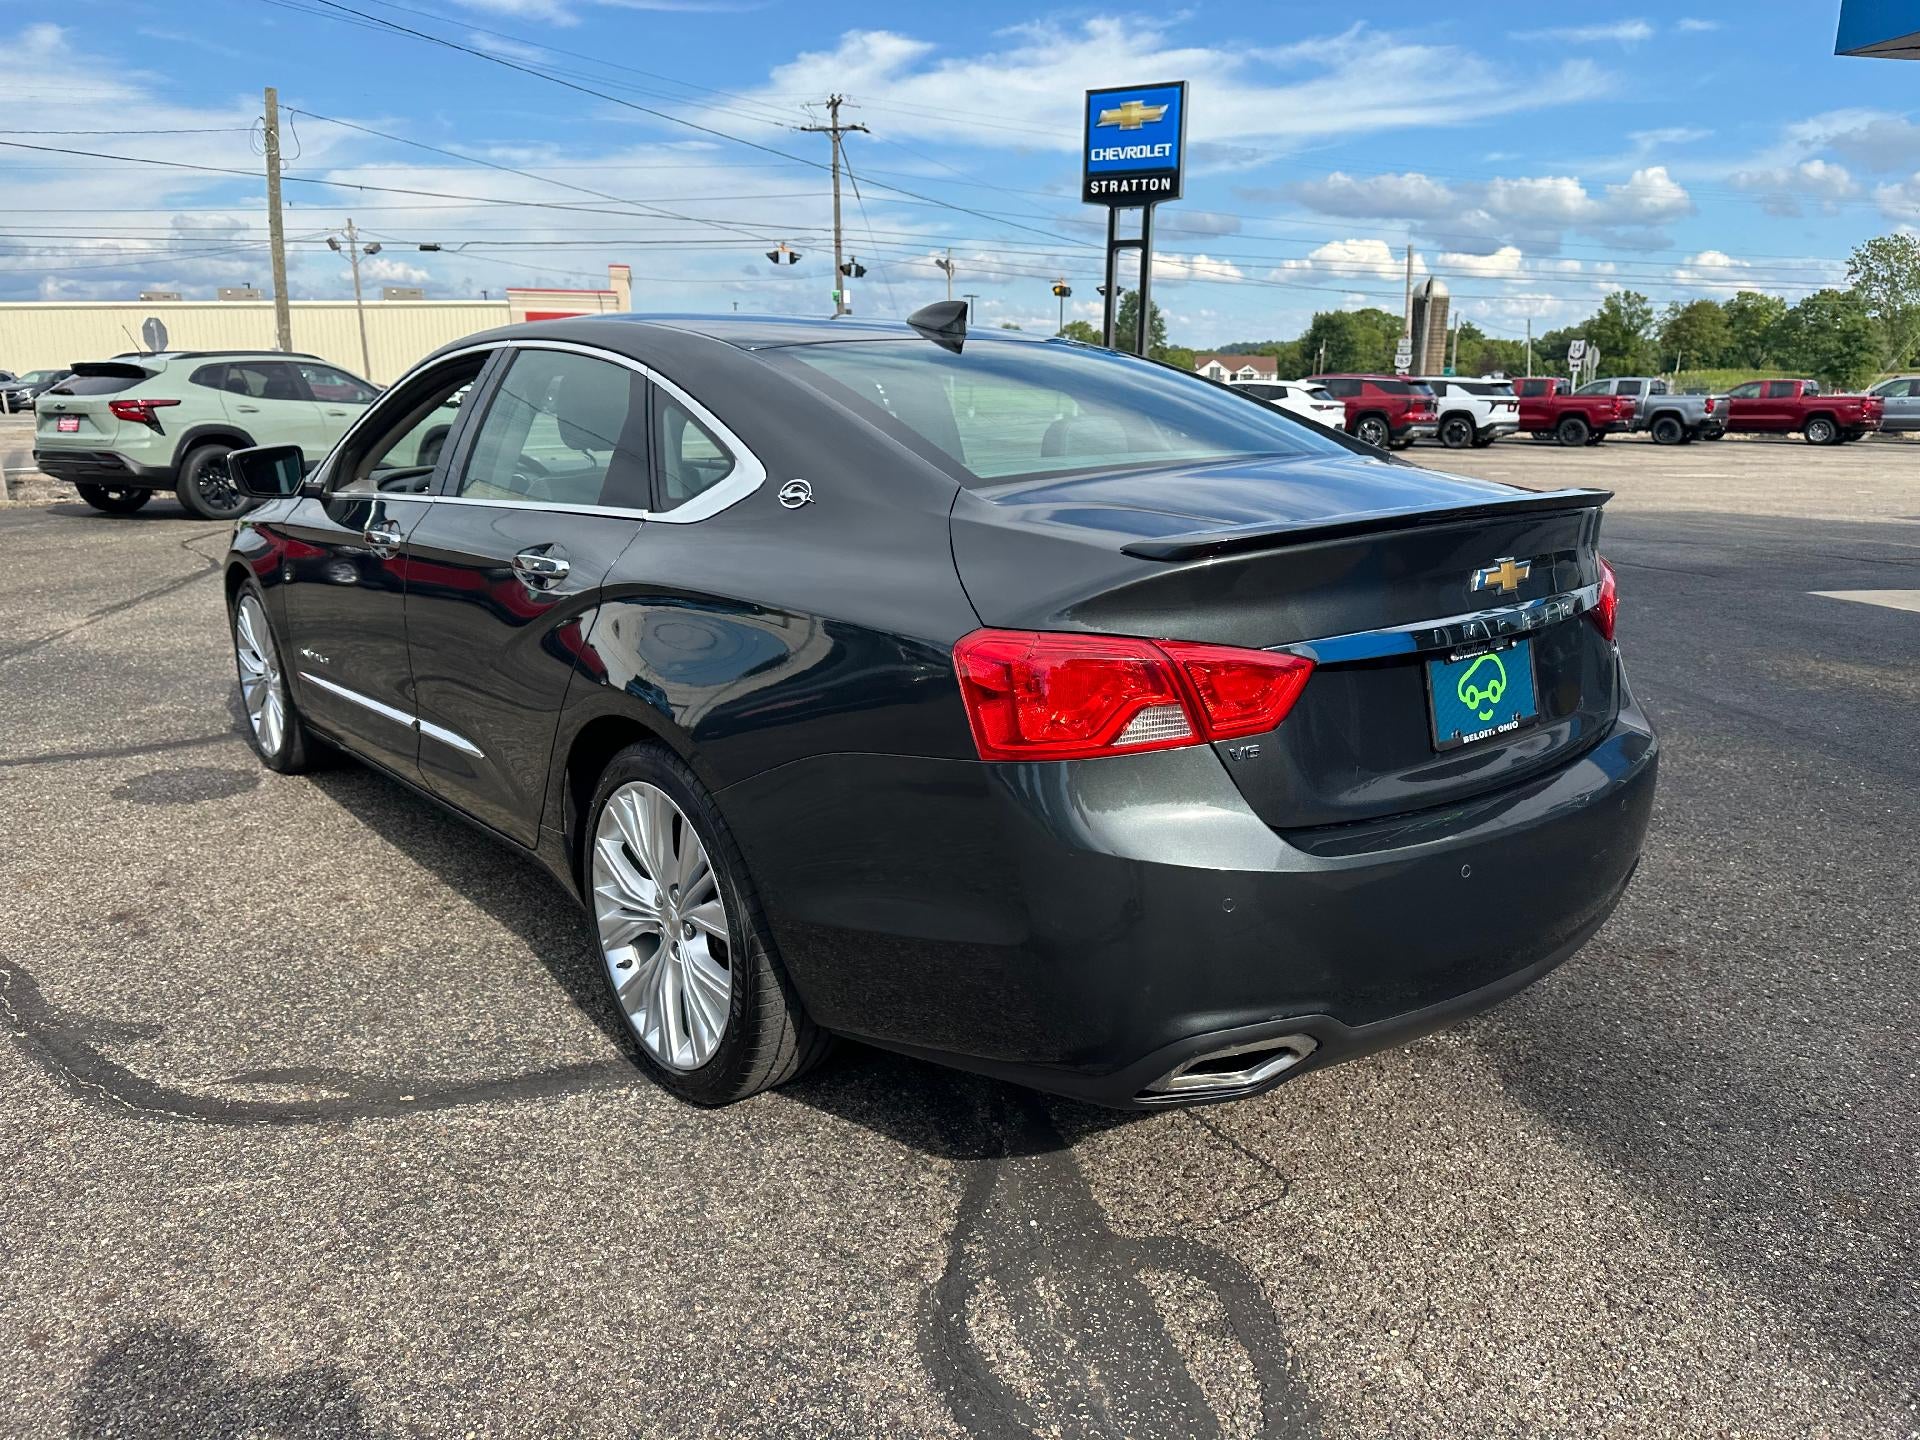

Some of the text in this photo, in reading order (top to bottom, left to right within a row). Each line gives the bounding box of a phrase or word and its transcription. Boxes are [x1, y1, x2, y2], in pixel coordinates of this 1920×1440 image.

[1091, 143, 1172, 161] CHEVROLET
[1090, 178, 1171, 194] STRATTON
[1463, 721, 1519, 744] BELOIT, OHIO
[1229, 744, 1261, 761] V6
